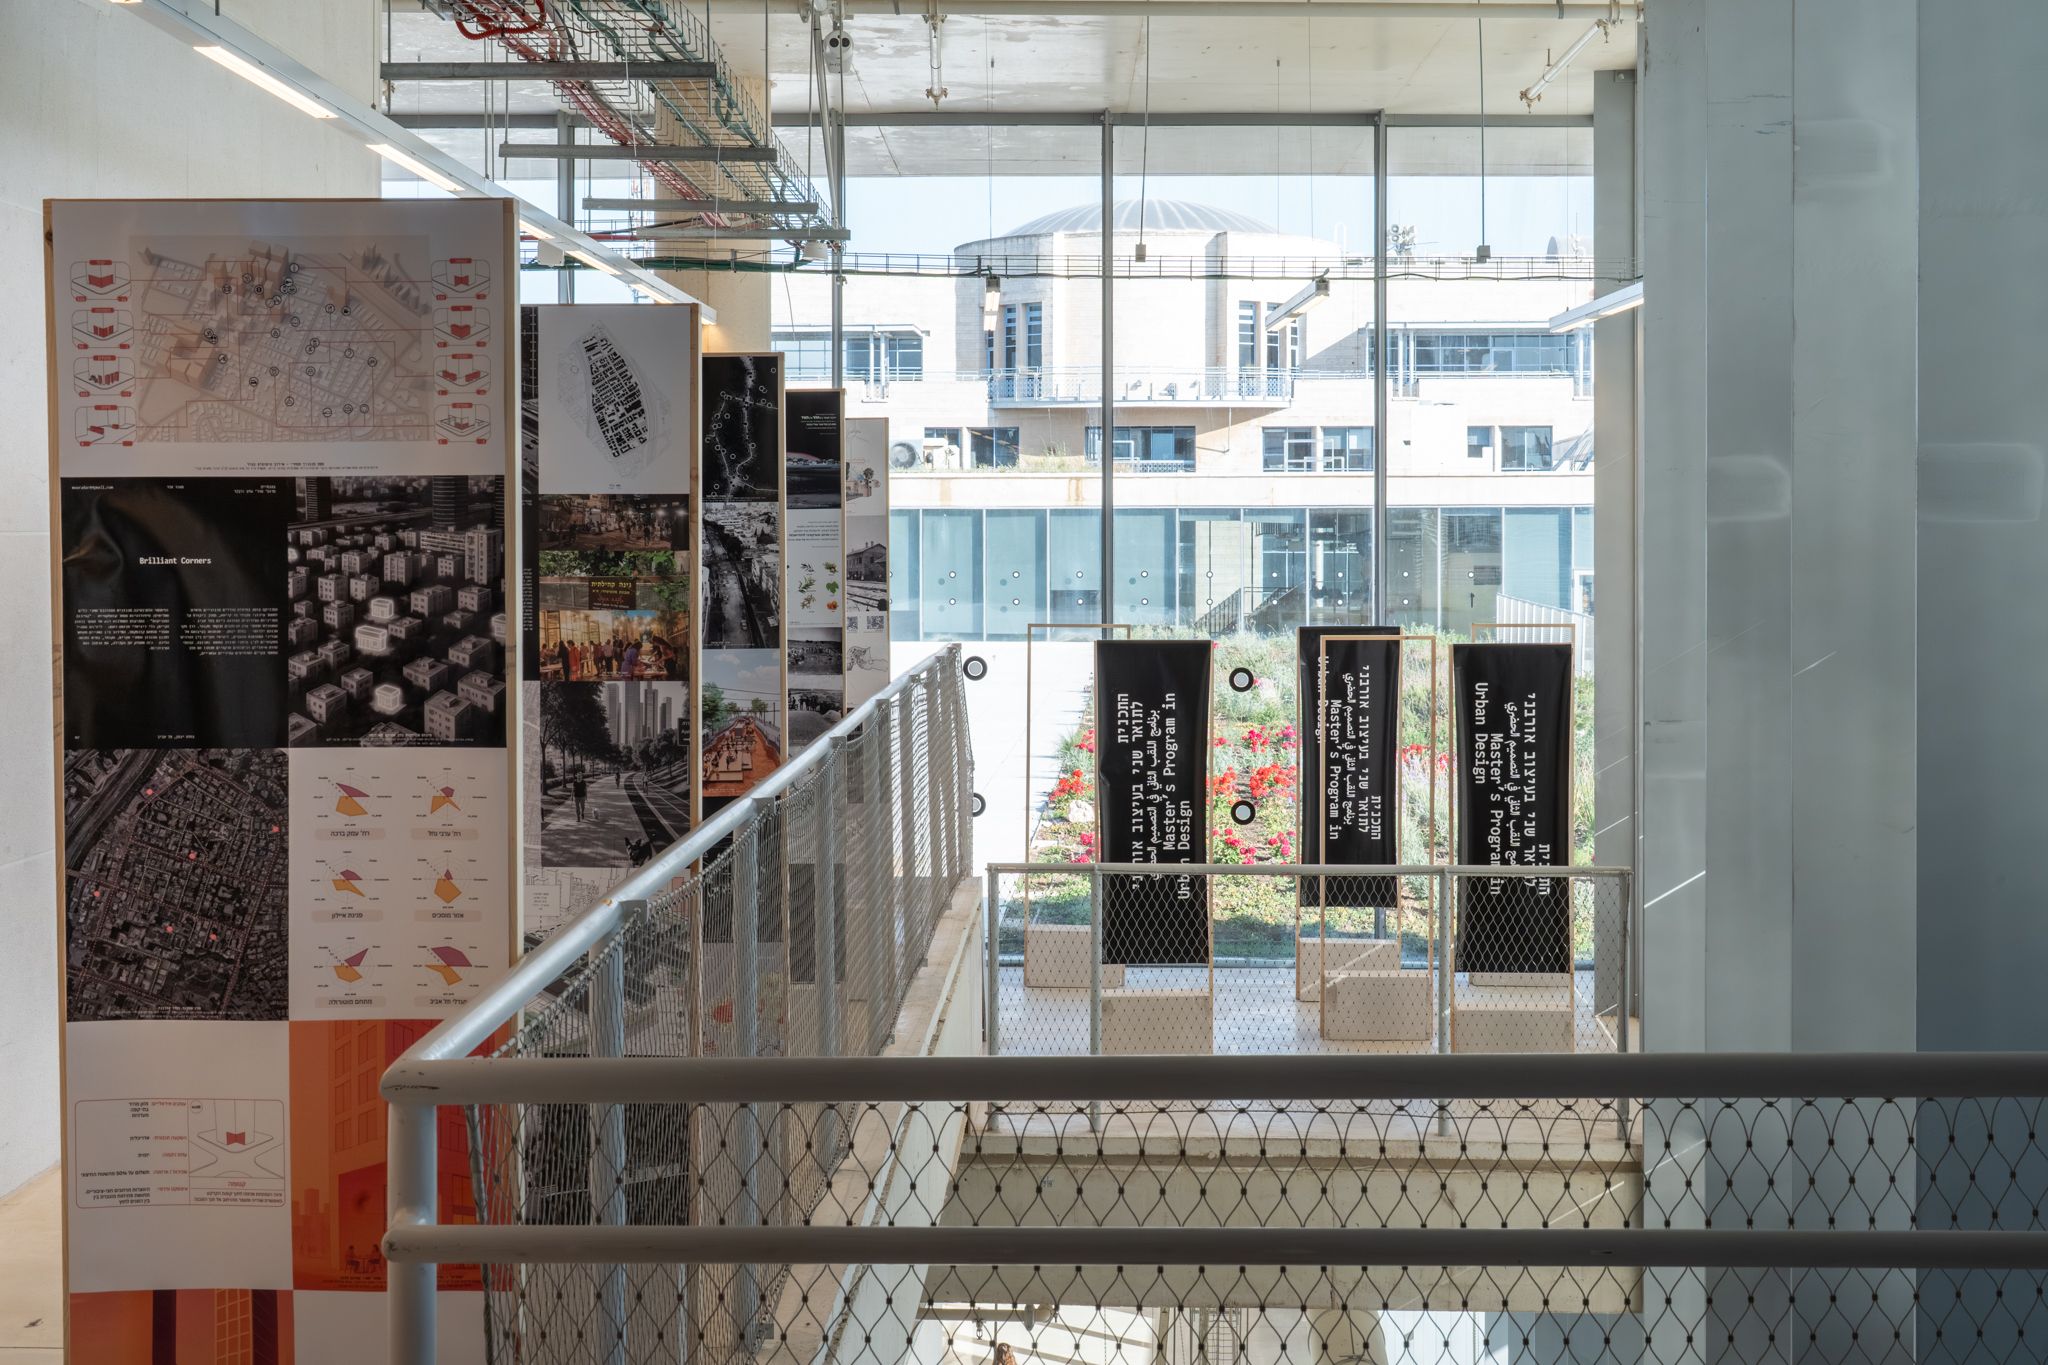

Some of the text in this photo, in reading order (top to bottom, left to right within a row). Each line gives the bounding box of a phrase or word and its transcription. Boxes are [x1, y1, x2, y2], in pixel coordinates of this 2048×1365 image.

[139, 556, 212, 564] Brilliant Corners
[1118, 694, 1128, 743] התכנית
[1147, 710, 1161, 737] برنامج
[1472, 682, 1489, 784] Urban Design
[1504, 702, 1520, 737] الحضري
[1524, 693, 1536, 743] אורבני
[1147, 741, 1160, 767] اللقب
[1342, 673, 1356, 825] برنامج اللقب الثاني في التصميم الحضري
[1359, 665, 1370, 832] לתואר שני בעיצוב אורבני
[1490, 734, 1504, 801] Master's
[1504, 740, 1520, 778] التصميم
[1147, 770, 1162, 790] الثاني
[1162, 693, 1178, 850] Master's Program in
[1328, 700, 1342, 840] Master's Program in
[1504, 782, 1520, 791] في
[1523, 752, 1536, 802] בעיצוב
[1130, 702, 1144, 890] לתואר שני בעיצוב אורני
[1147, 794, 1162, 803] في
[1504, 796, 1520, 815] الثاني
[1147, 807, 1162, 844] التصميم
[1371, 796, 1381, 840] התכנית
[1506, 820, 1520, 846] اللقب
[1524, 812, 1535, 836] שני
[1177, 800, 1192, 899] Urbn Design
[1490, 878, 1504, 894] in
